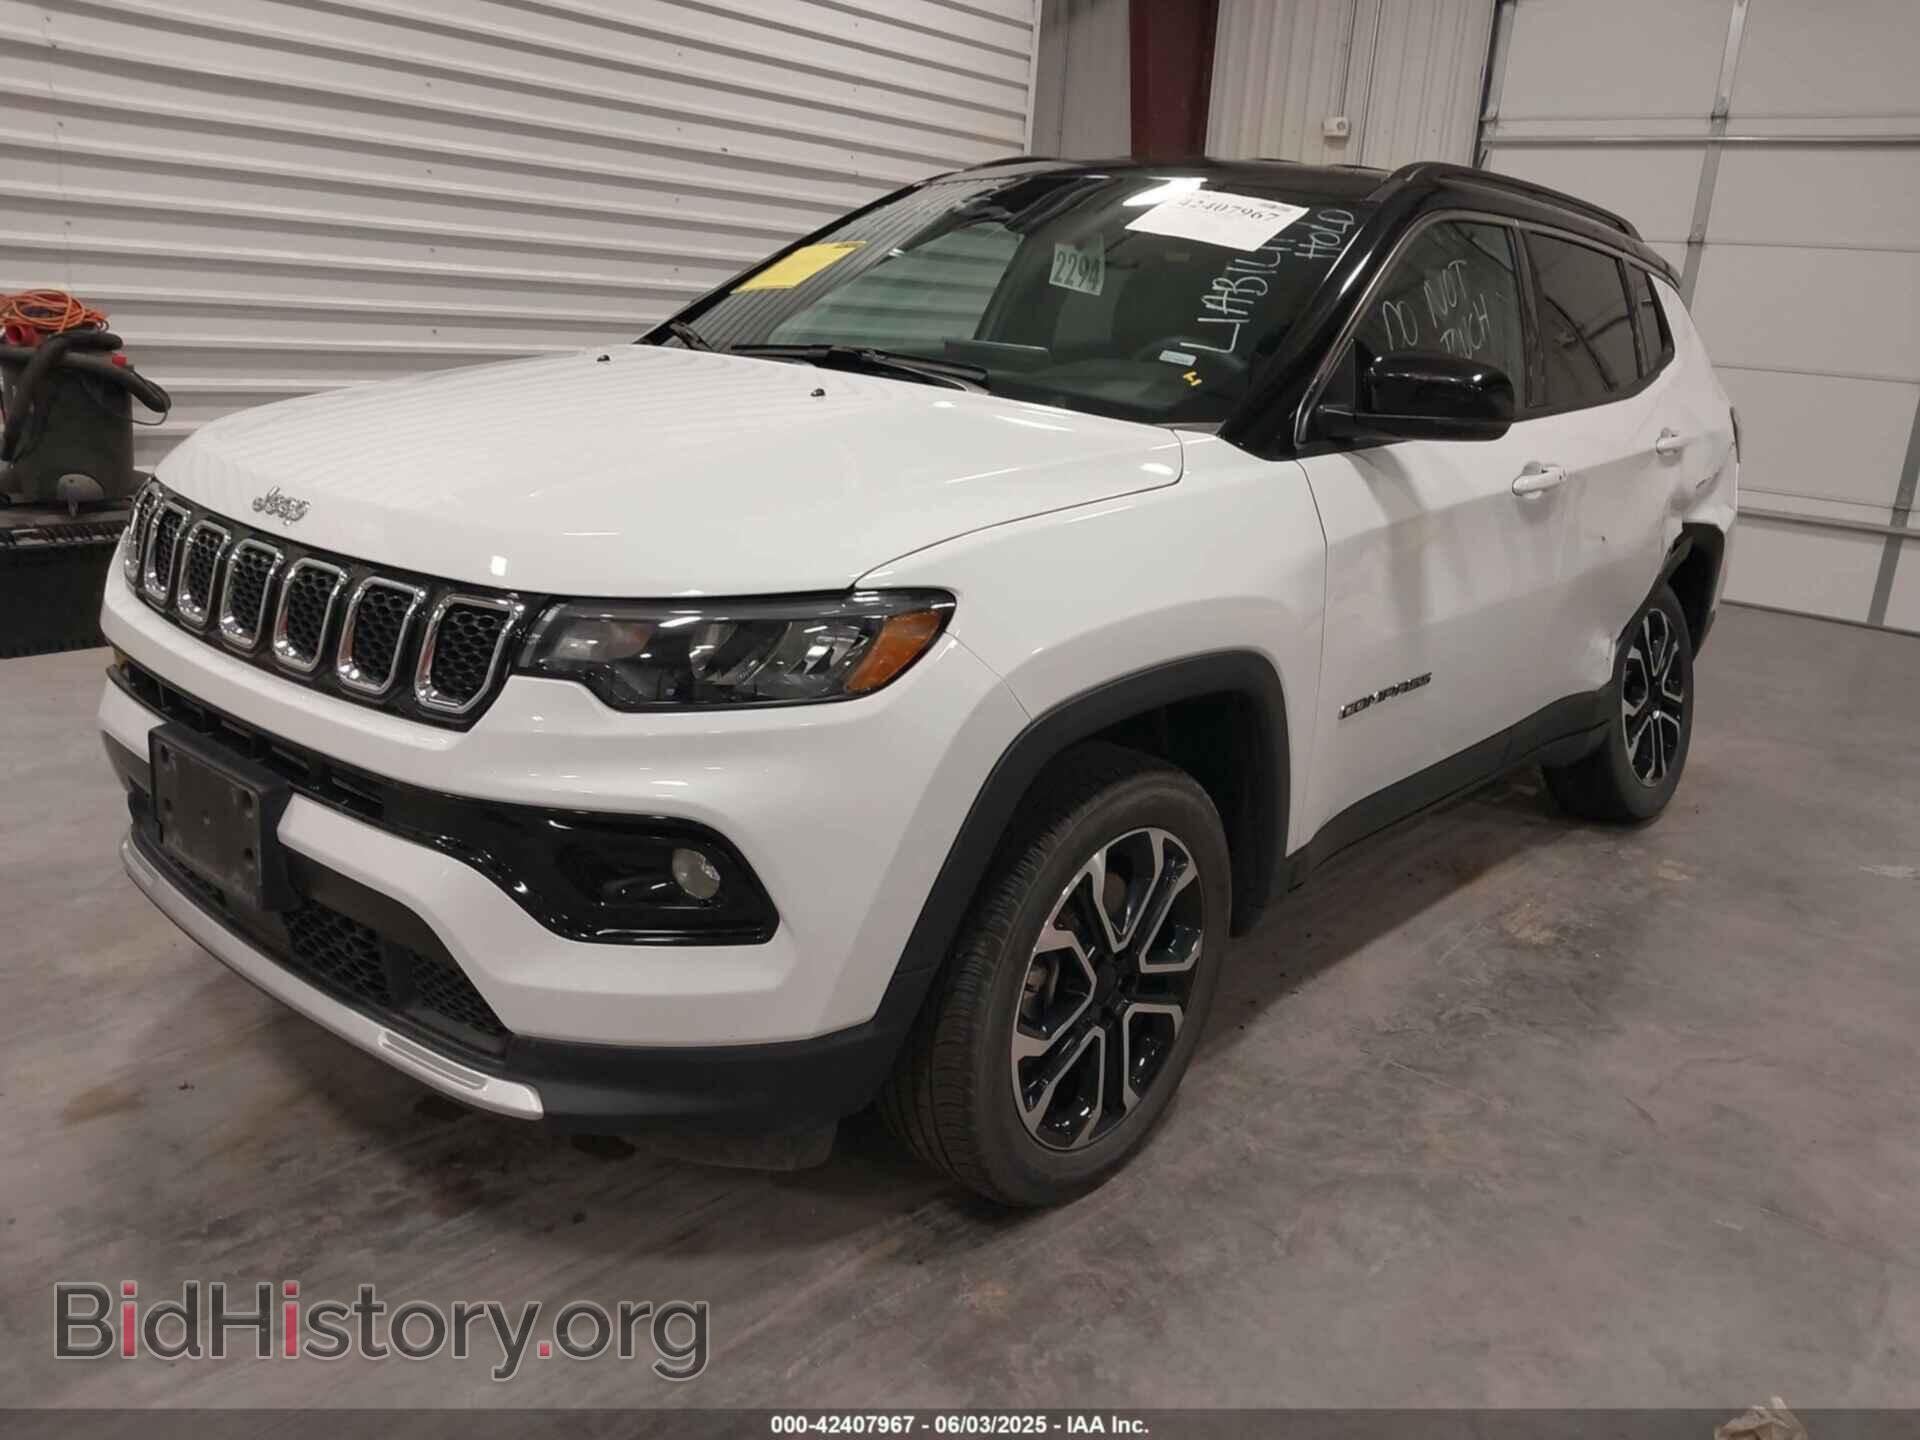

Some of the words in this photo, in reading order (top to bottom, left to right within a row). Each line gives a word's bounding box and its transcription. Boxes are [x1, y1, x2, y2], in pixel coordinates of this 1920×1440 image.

[1294, 209, 1355, 259] HOLD
[1053, 250, 1101, 291] 2294
[1382, 300, 1418, 351] DO
[1423, 260, 1467, 328] NOT
[252, 485, 312, 527] Jeep
